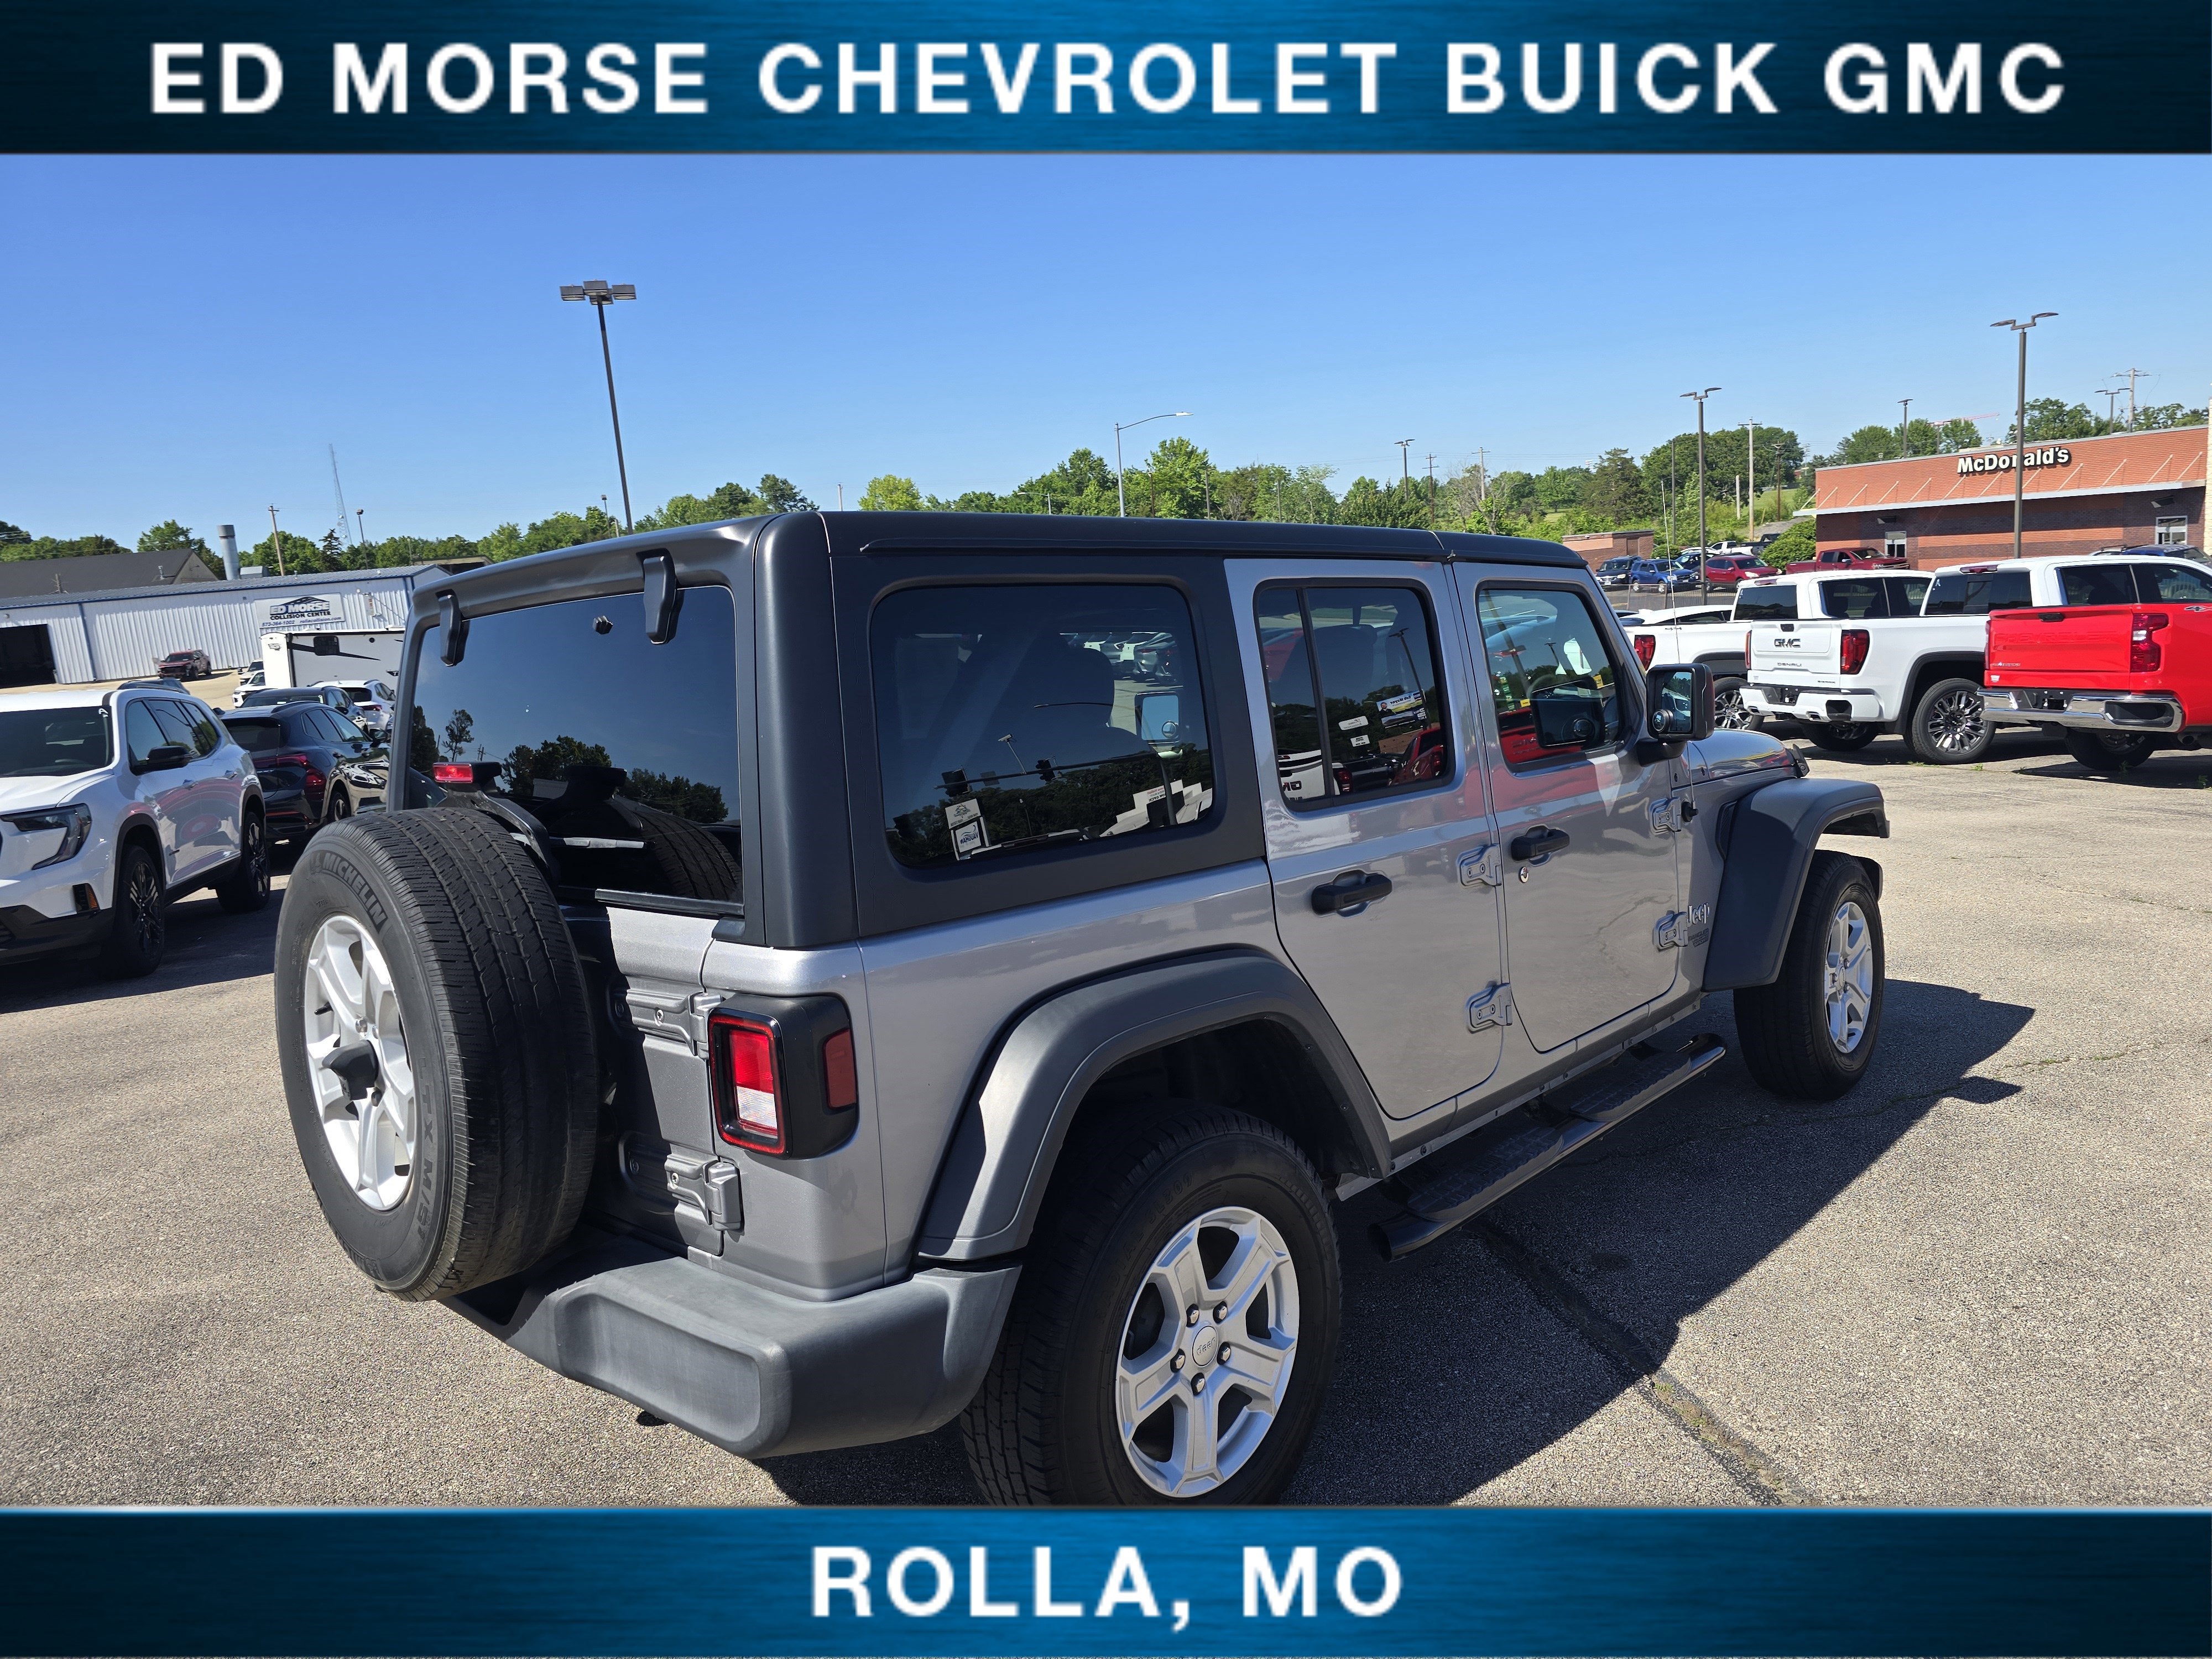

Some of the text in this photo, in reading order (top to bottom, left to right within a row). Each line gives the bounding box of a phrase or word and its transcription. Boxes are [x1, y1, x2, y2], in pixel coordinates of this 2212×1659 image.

[270, 601, 330, 615] ED MORSE
[1774, 638, 1801, 648] GMC
[322, 852, 387, 926] MICHELIN
[1687, 902, 1710, 927] Jeep
[1196, 1337, 1215, 1356] Jeep
